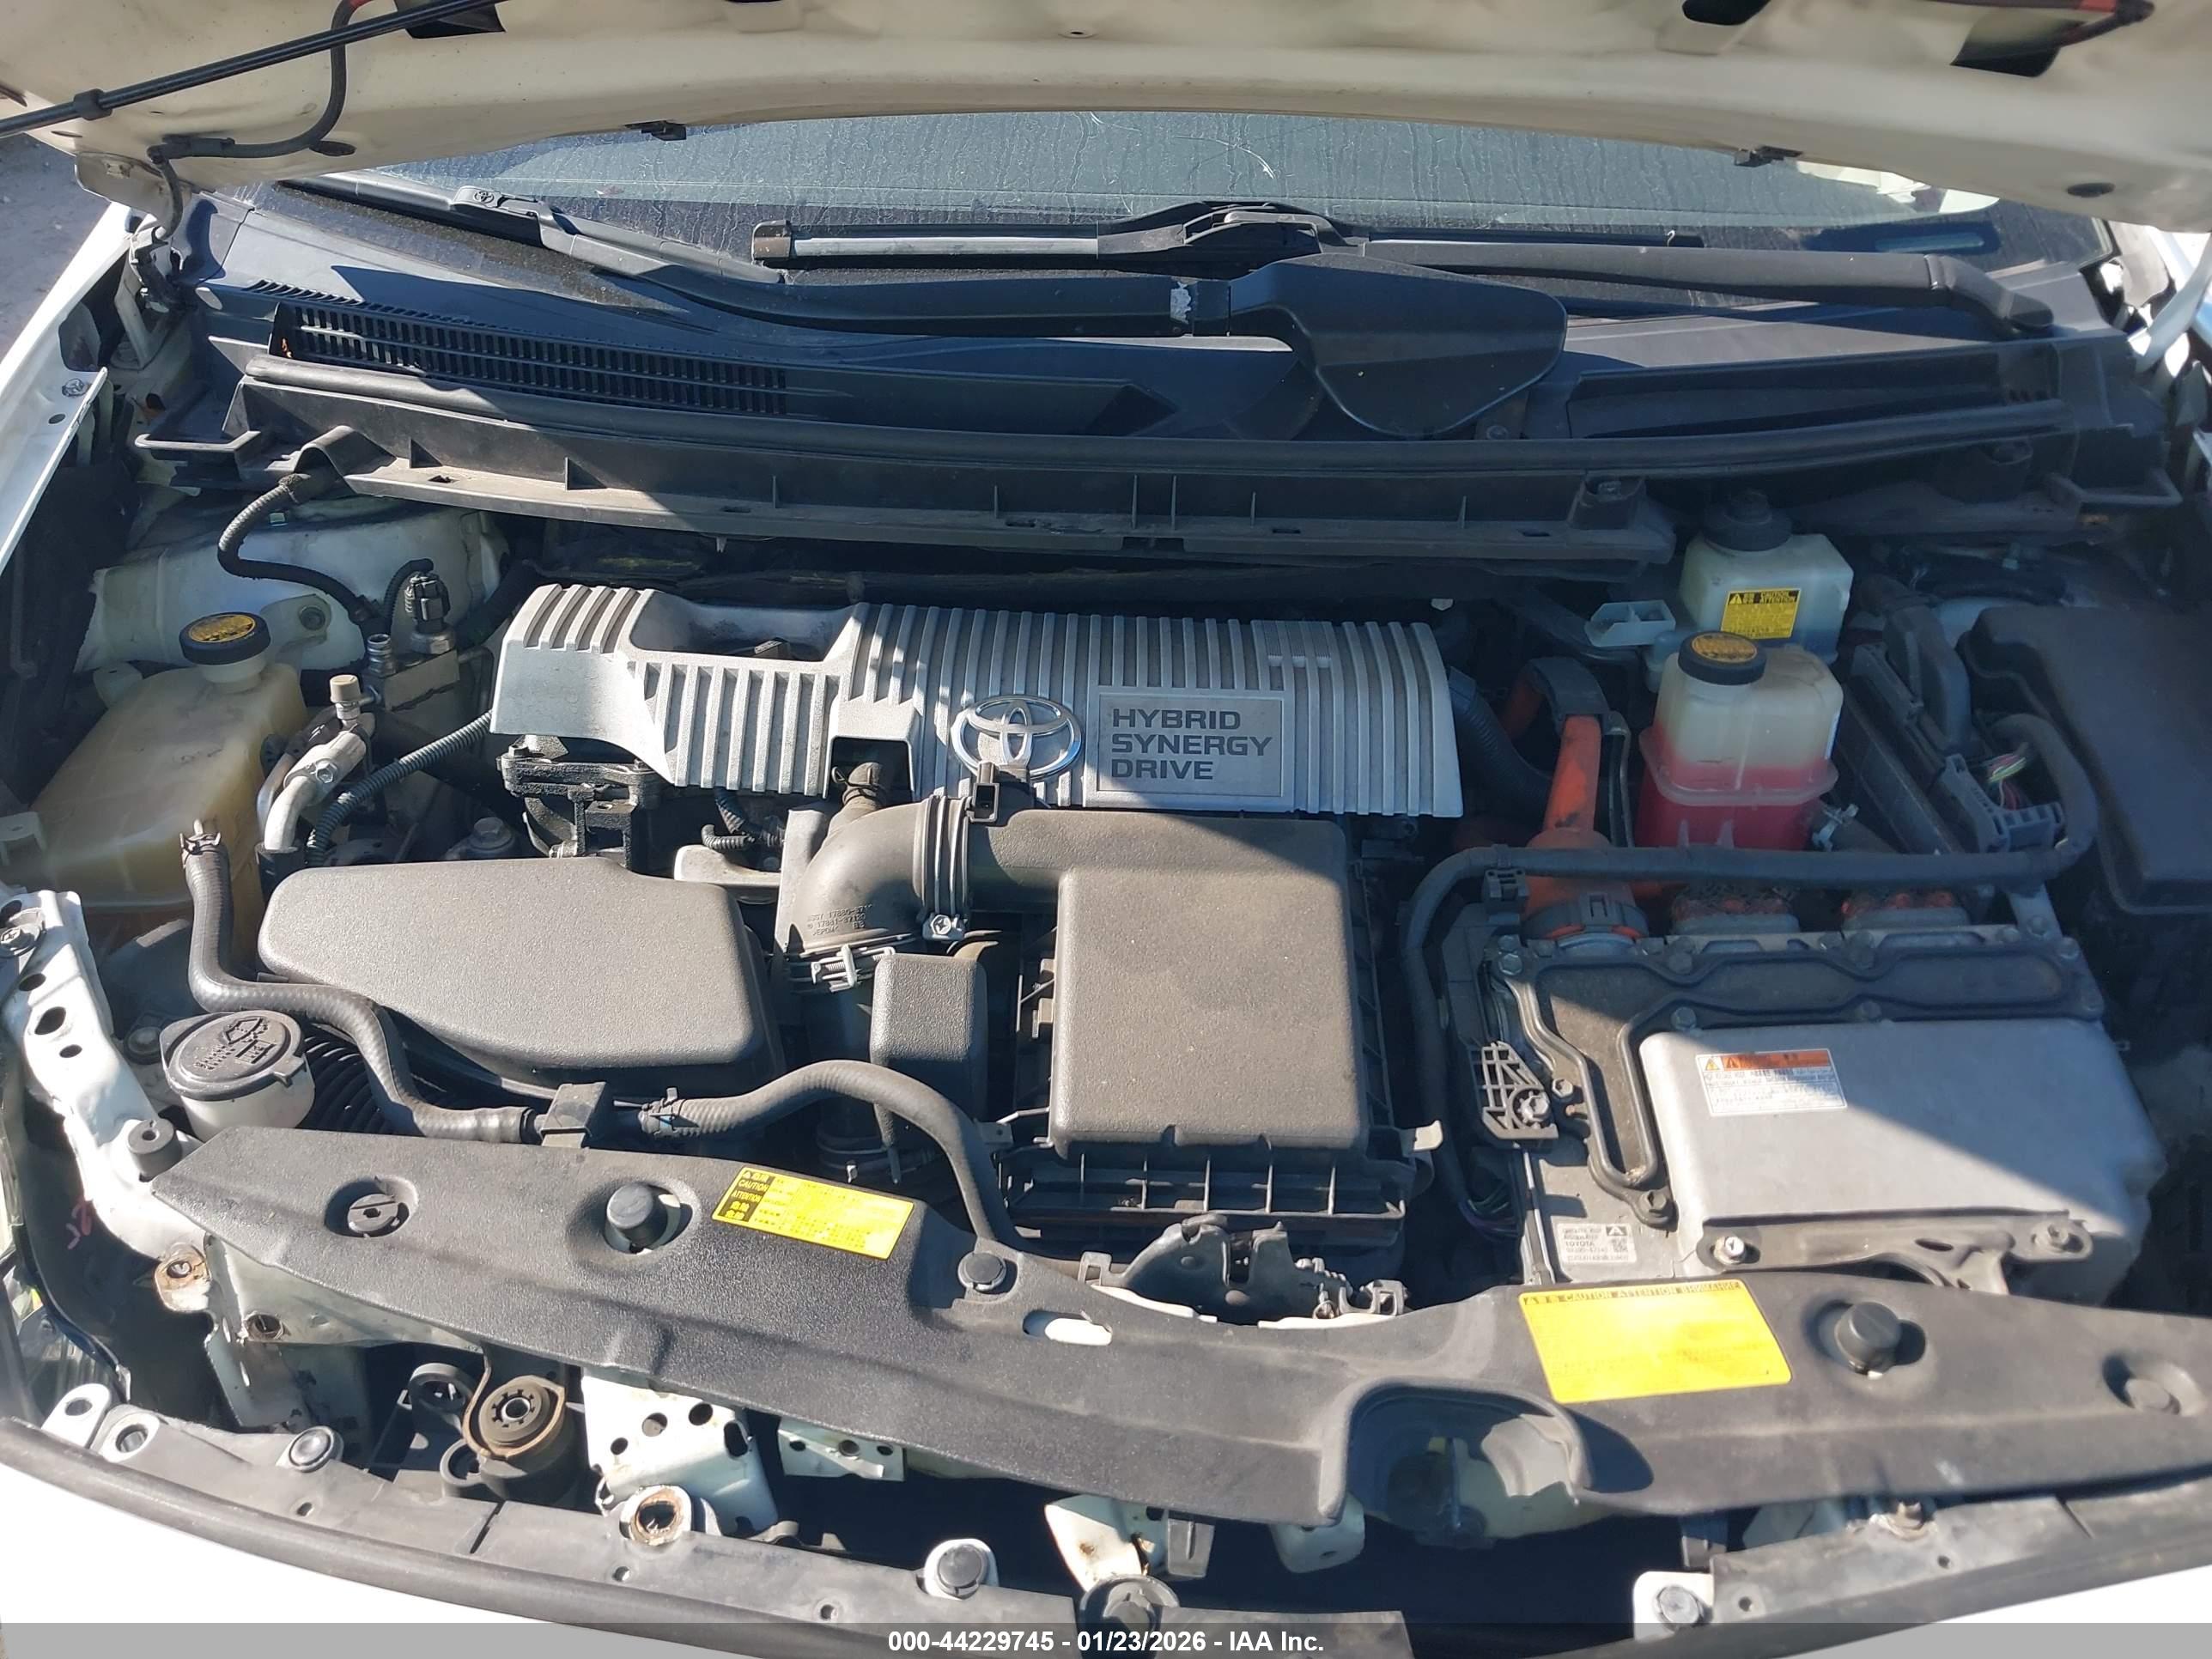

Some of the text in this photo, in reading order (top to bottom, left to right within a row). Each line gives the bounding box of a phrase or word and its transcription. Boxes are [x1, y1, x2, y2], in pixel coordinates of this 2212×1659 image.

[1111, 708, 1240, 731] HYBRID
[1111, 734, 1273, 757] SYNERGY
[1111, 759, 1214, 781] DRIVE
[738, 1179, 770, 1192] CAUTION
[730, 1189, 763, 1204] ATTENTION
[1565, 1290, 1612, 1302] CAUTION
[1618, 1286, 1678, 1298] ATTENTION
